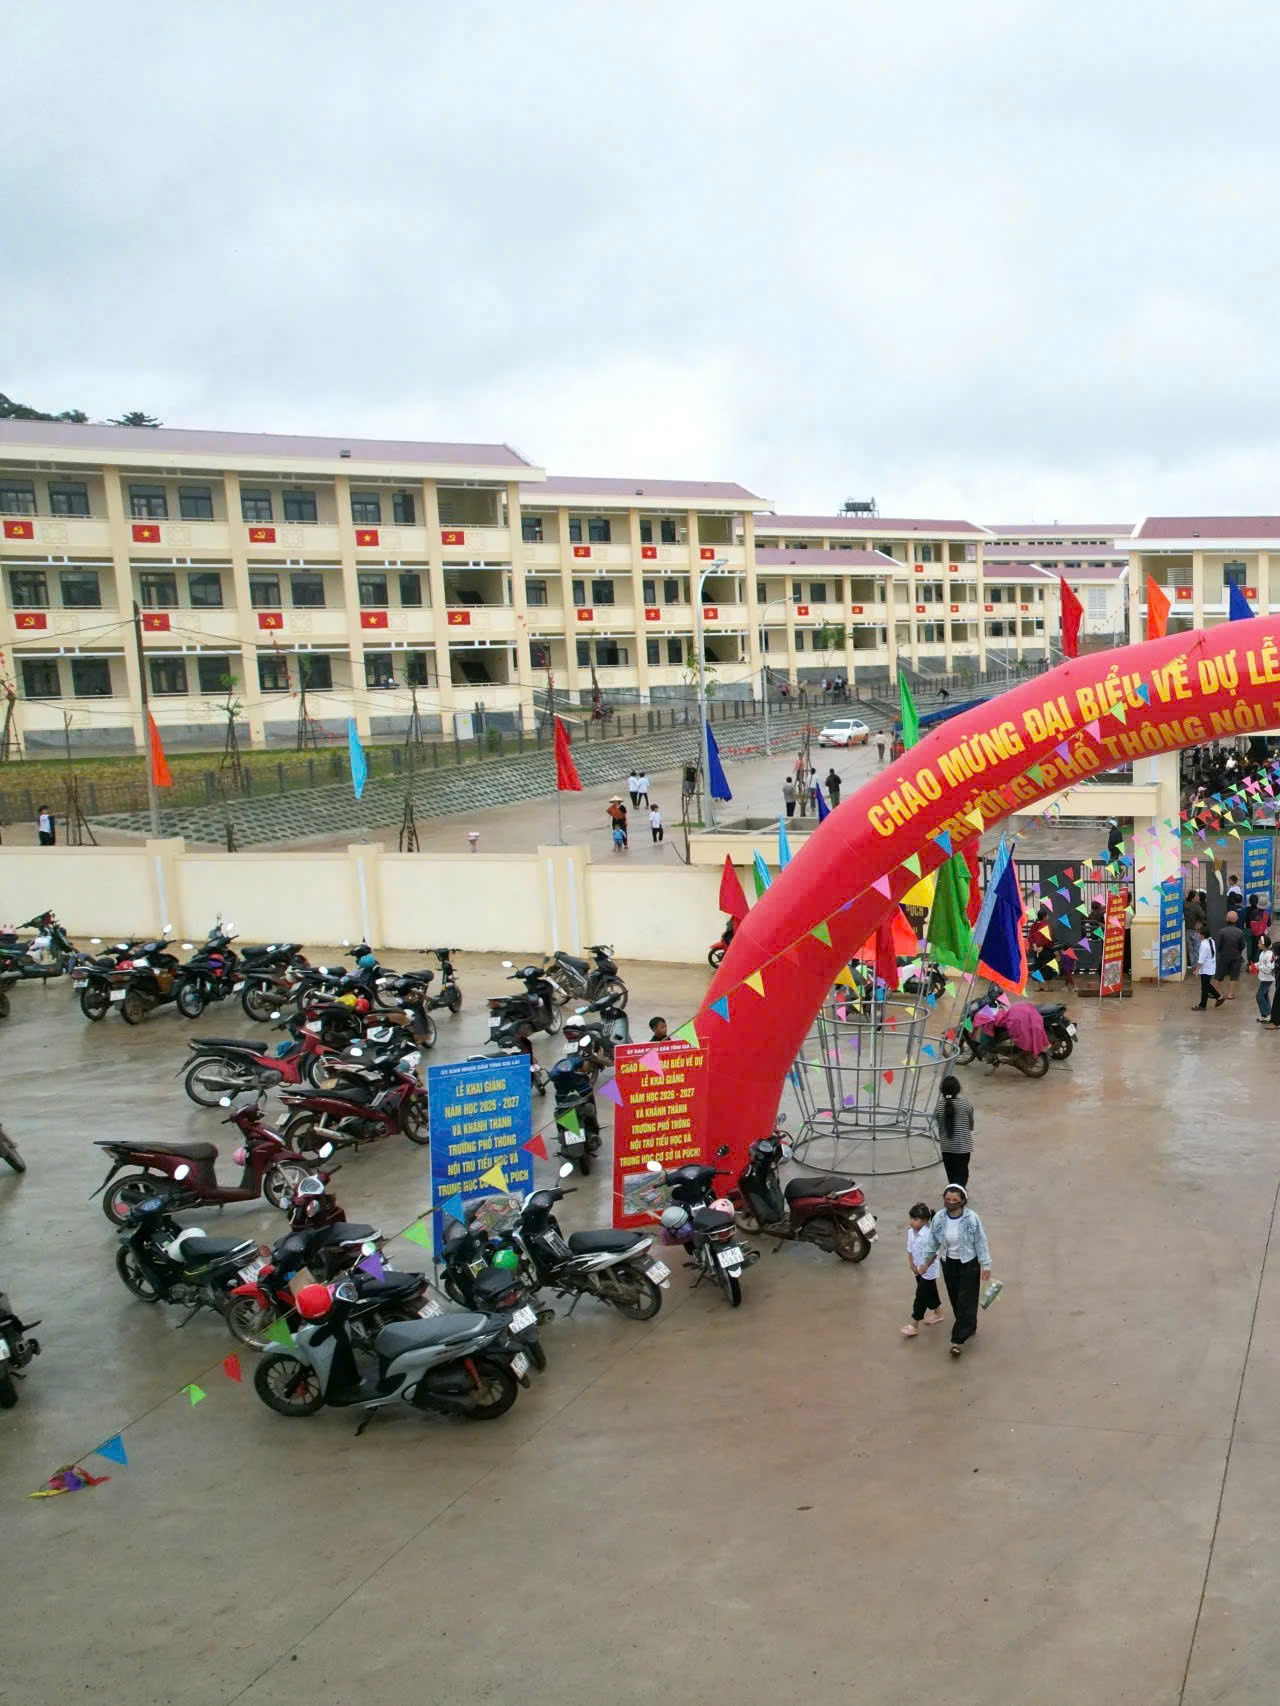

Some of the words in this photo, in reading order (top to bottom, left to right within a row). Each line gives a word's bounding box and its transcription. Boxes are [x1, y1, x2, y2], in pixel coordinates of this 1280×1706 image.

[868, 768, 942, 836] CHÀO
[937, 721, 1026, 788] MỪNG
[1022, 695, 1075, 743] ĐẠI
[1076, 665, 1145, 723] BIỂU
[1198, 649, 1238, 696] DỰ
[1102, 716, 1206, 760] THÔNG
